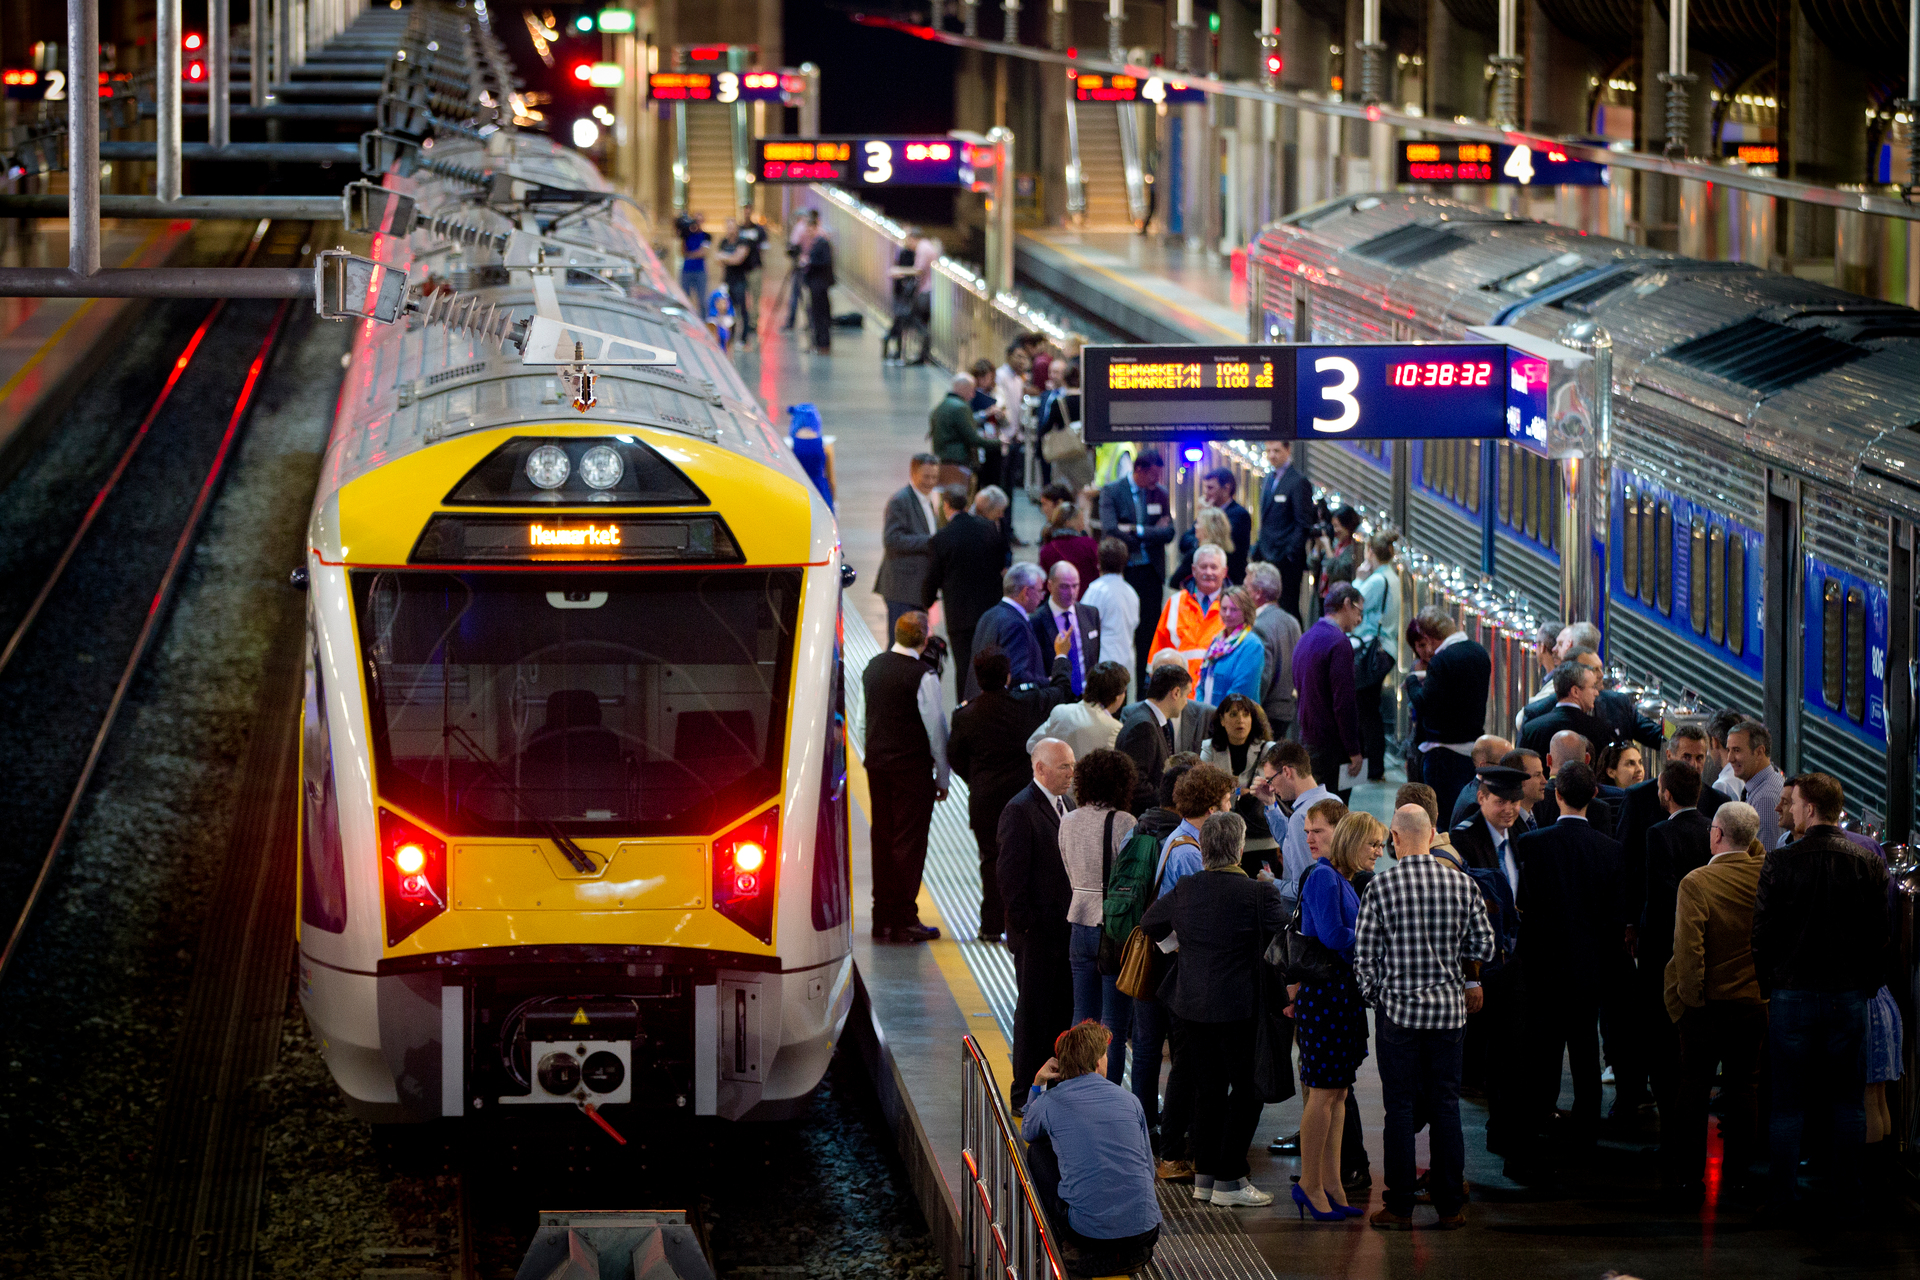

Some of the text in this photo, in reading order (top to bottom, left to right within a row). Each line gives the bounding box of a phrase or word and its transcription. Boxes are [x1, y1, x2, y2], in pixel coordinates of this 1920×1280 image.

[44, 70, 66, 100] 2
[717, 71, 739, 103] 3
[861, 141, 892, 184] 3
[1503, 144, 1534, 184] 4
[1109, 363, 1274, 376] NEWMARKET/N 1040 2
[1109, 376, 1274, 389] NEWMARKET/N 1100 22
[1395, 363, 1491, 386] 10:38:32
[1312, 356, 1360, 433] 3
[529, 523, 622, 546] Newmarket
[1872, 645, 1884, 681] 806
